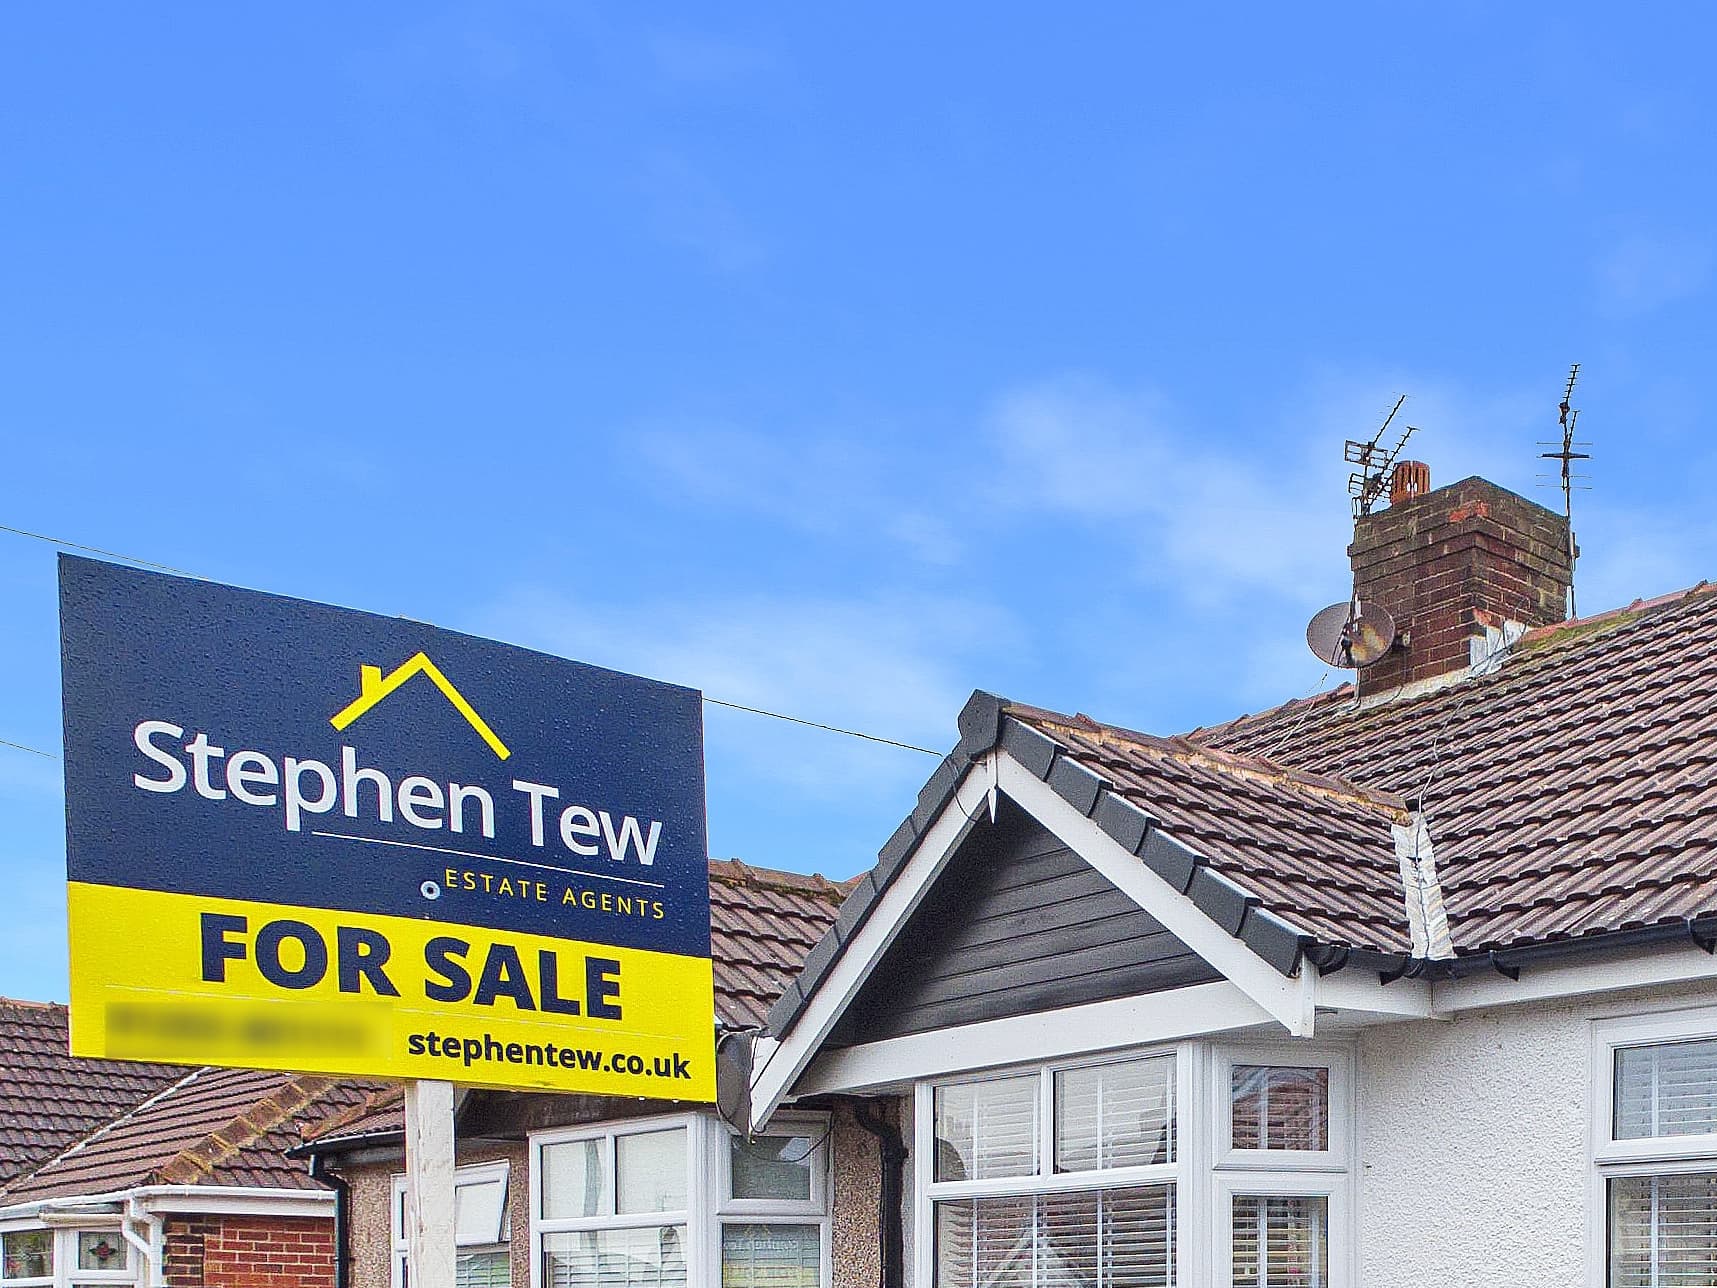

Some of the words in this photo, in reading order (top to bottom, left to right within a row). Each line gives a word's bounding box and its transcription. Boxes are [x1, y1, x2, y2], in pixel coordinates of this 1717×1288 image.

[133, 720, 495, 838] Stephen
[512, 779, 663, 866] Tew
[445, 868, 548, 902] ESTATE
[562, 887, 665, 920] AGENTS
[200, 912, 401, 997] FOR
[424, 936, 623, 1021] SALE
[408, 1031, 692, 1080] stephentew.co.uk
